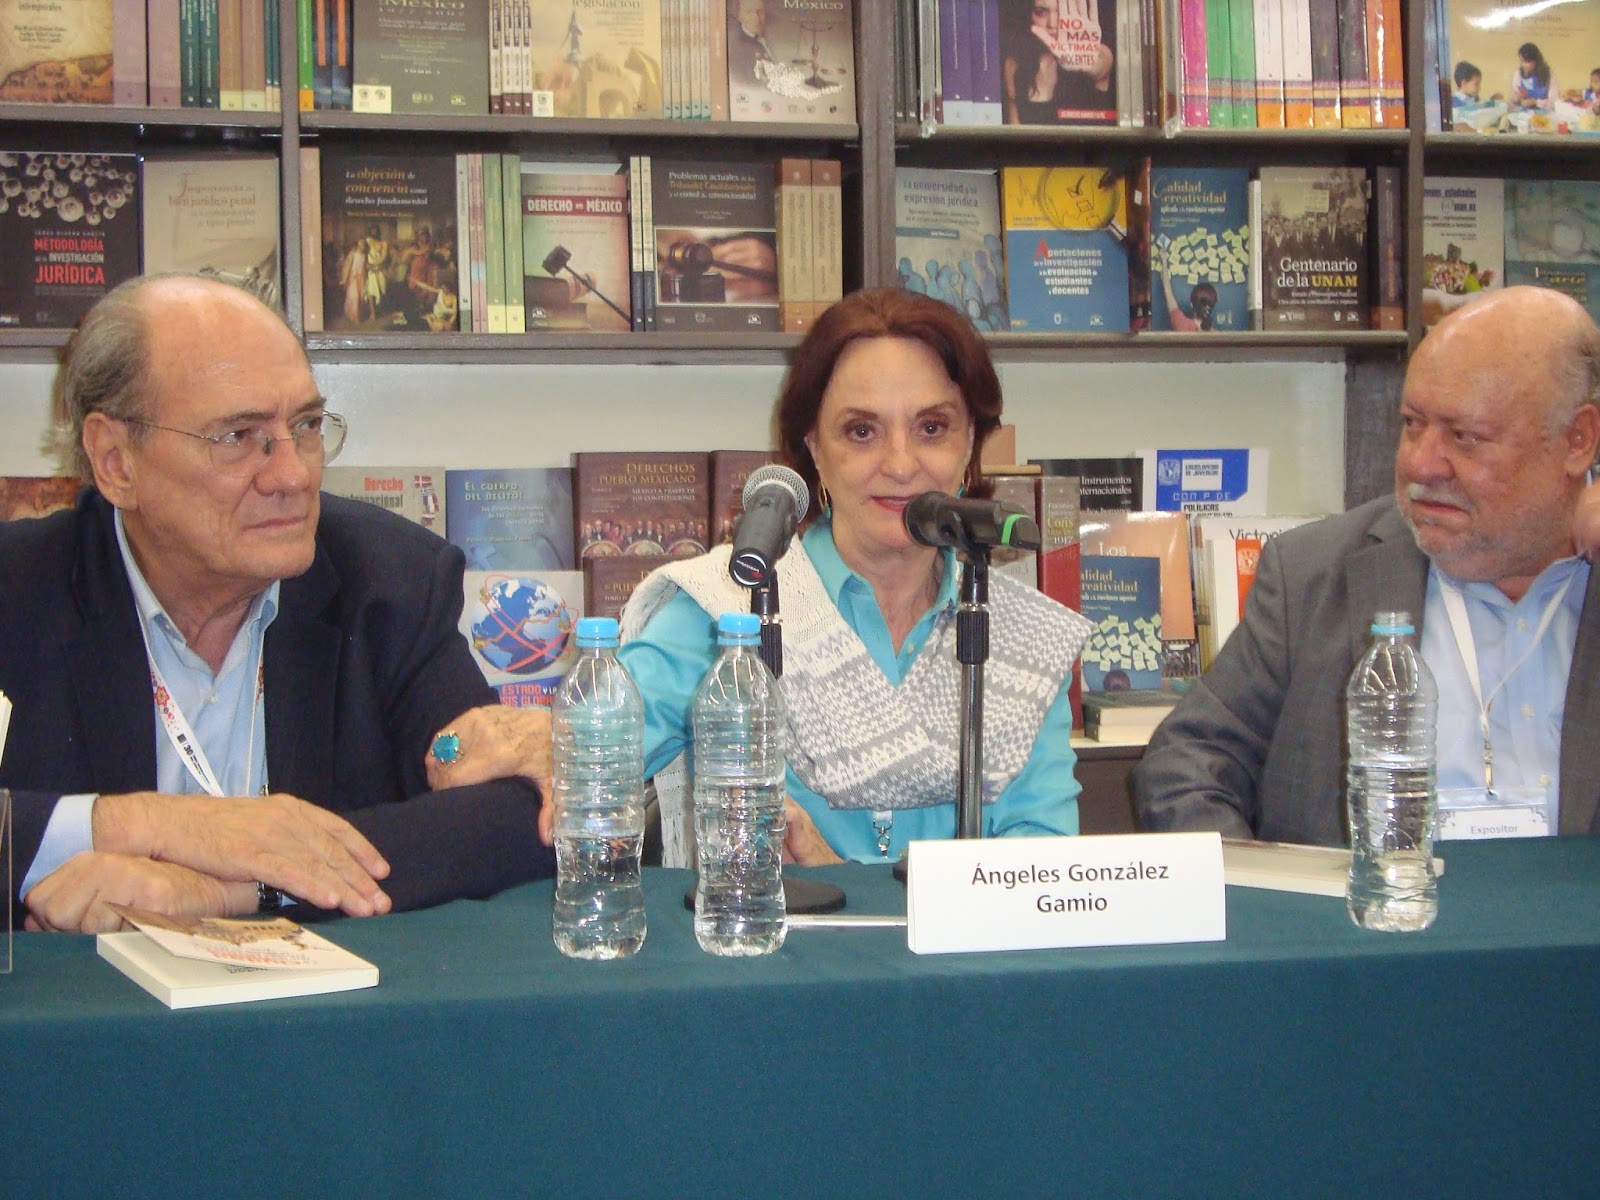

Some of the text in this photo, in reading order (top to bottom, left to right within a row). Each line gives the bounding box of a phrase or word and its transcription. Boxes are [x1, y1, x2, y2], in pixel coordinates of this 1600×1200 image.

[1060, 19, 1083, 30] NO
[357, 167, 406, 182] objeción
[669, 171, 707, 180] Problemas
[709, 172, 739, 181] actuales
[345, 184, 409, 194] conciencia
[913, 182, 964, 194] universidad
[345, 196, 428, 206] derecho fundamental
[904, 194, 979, 208] expresión jurídica
[1161, 190, 1227, 204] creatividad
[527, 199, 573, 212] DERECHO
[586, 198, 623, 213] MÉXICO
[34, 238, 105, 251] METODOLOGÍA
[1034, 239, 1103, 260] Aportaciones
[49, 251, 105, 264] INVESTIGACIÓN
[1044, 257, 1103, 268] investigación
[1280, 256, 1358, 273] Centenario
[35, 262, 106, 285] JURÍDICA
[1047, 266, 1092, 276] evaluación
[1045, 277, 1093, 286] estudiantes
[1277, 272, 1358, 288] de la UNAM
[626, 463, 696, 474] DERECHOS
[364, 476, 404, 491] Derecho
[599, 474, 697, 486] PUEBLO MEXICANO
[1081, 476, 1132, 486] Instrumentos
[480, 483, 519, 492] CUERPO
[1079, 485, 1132, 496] nternacionales
[465, 493, 481, 501] DEL
[1203, 493, 1211, 501] P
[1216, 493, 1231, 501] DE
[1099, 541, 1128, 557] Los
[1081, 581, 1138, 593] reatividad
[501, 684, 542, 695] ESTADO
[183, 744, 194, 757] 30
[1470, 823, 1519, 836] Expositor
[970, 860, 1170, 889] Ángeles González
[1035, 893, 1109, 914] Gamio
